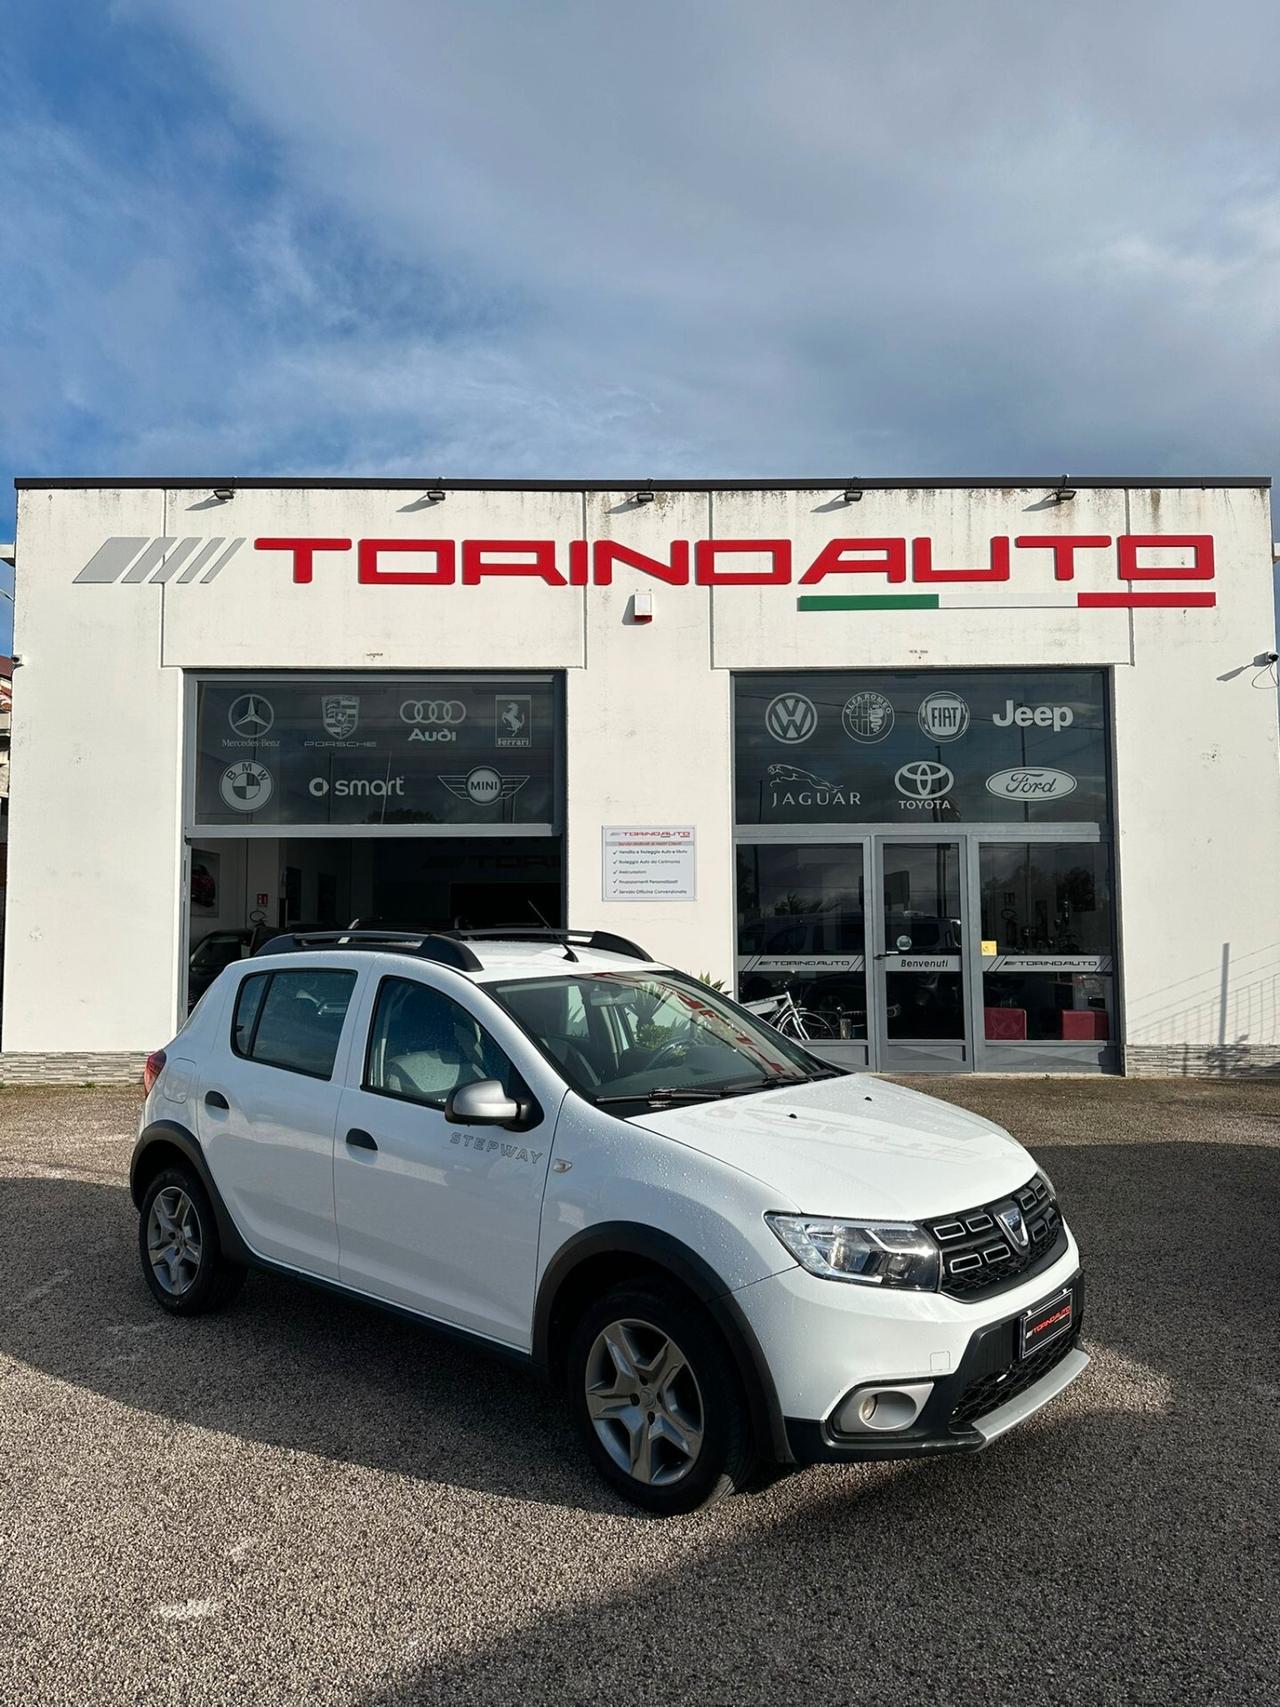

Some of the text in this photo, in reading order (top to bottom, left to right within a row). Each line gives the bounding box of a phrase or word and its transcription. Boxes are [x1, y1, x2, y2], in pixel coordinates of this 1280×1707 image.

[254, 535, 1215, 586] TORINOAUTO
[845, 693, 891, 714] ALFA ROMEO
[931, 707, 959, 728] FIAT
[992, 699, 1074, 732] Jeep
[408, 727, 457, 741] Audi
[497, 737, 530, 746] Ferrari
[222, 739, 280, 747] Mercedes-Benz
[304, 740, 377, 748] PORSCHE
[225, 762, 269, 781] BMW
[334, 776, 405, 796] smart
[470, 781, 498, 791] MINI
[1005, 772, 1057, 793] Ford
[772, 792, 862, 808] JAGUAR
[898, 800, 951, 809] TOYOTA
[900, 959, 949, 968] Benvenuti
[449, 1131, 544, 1165] STEPWAY
